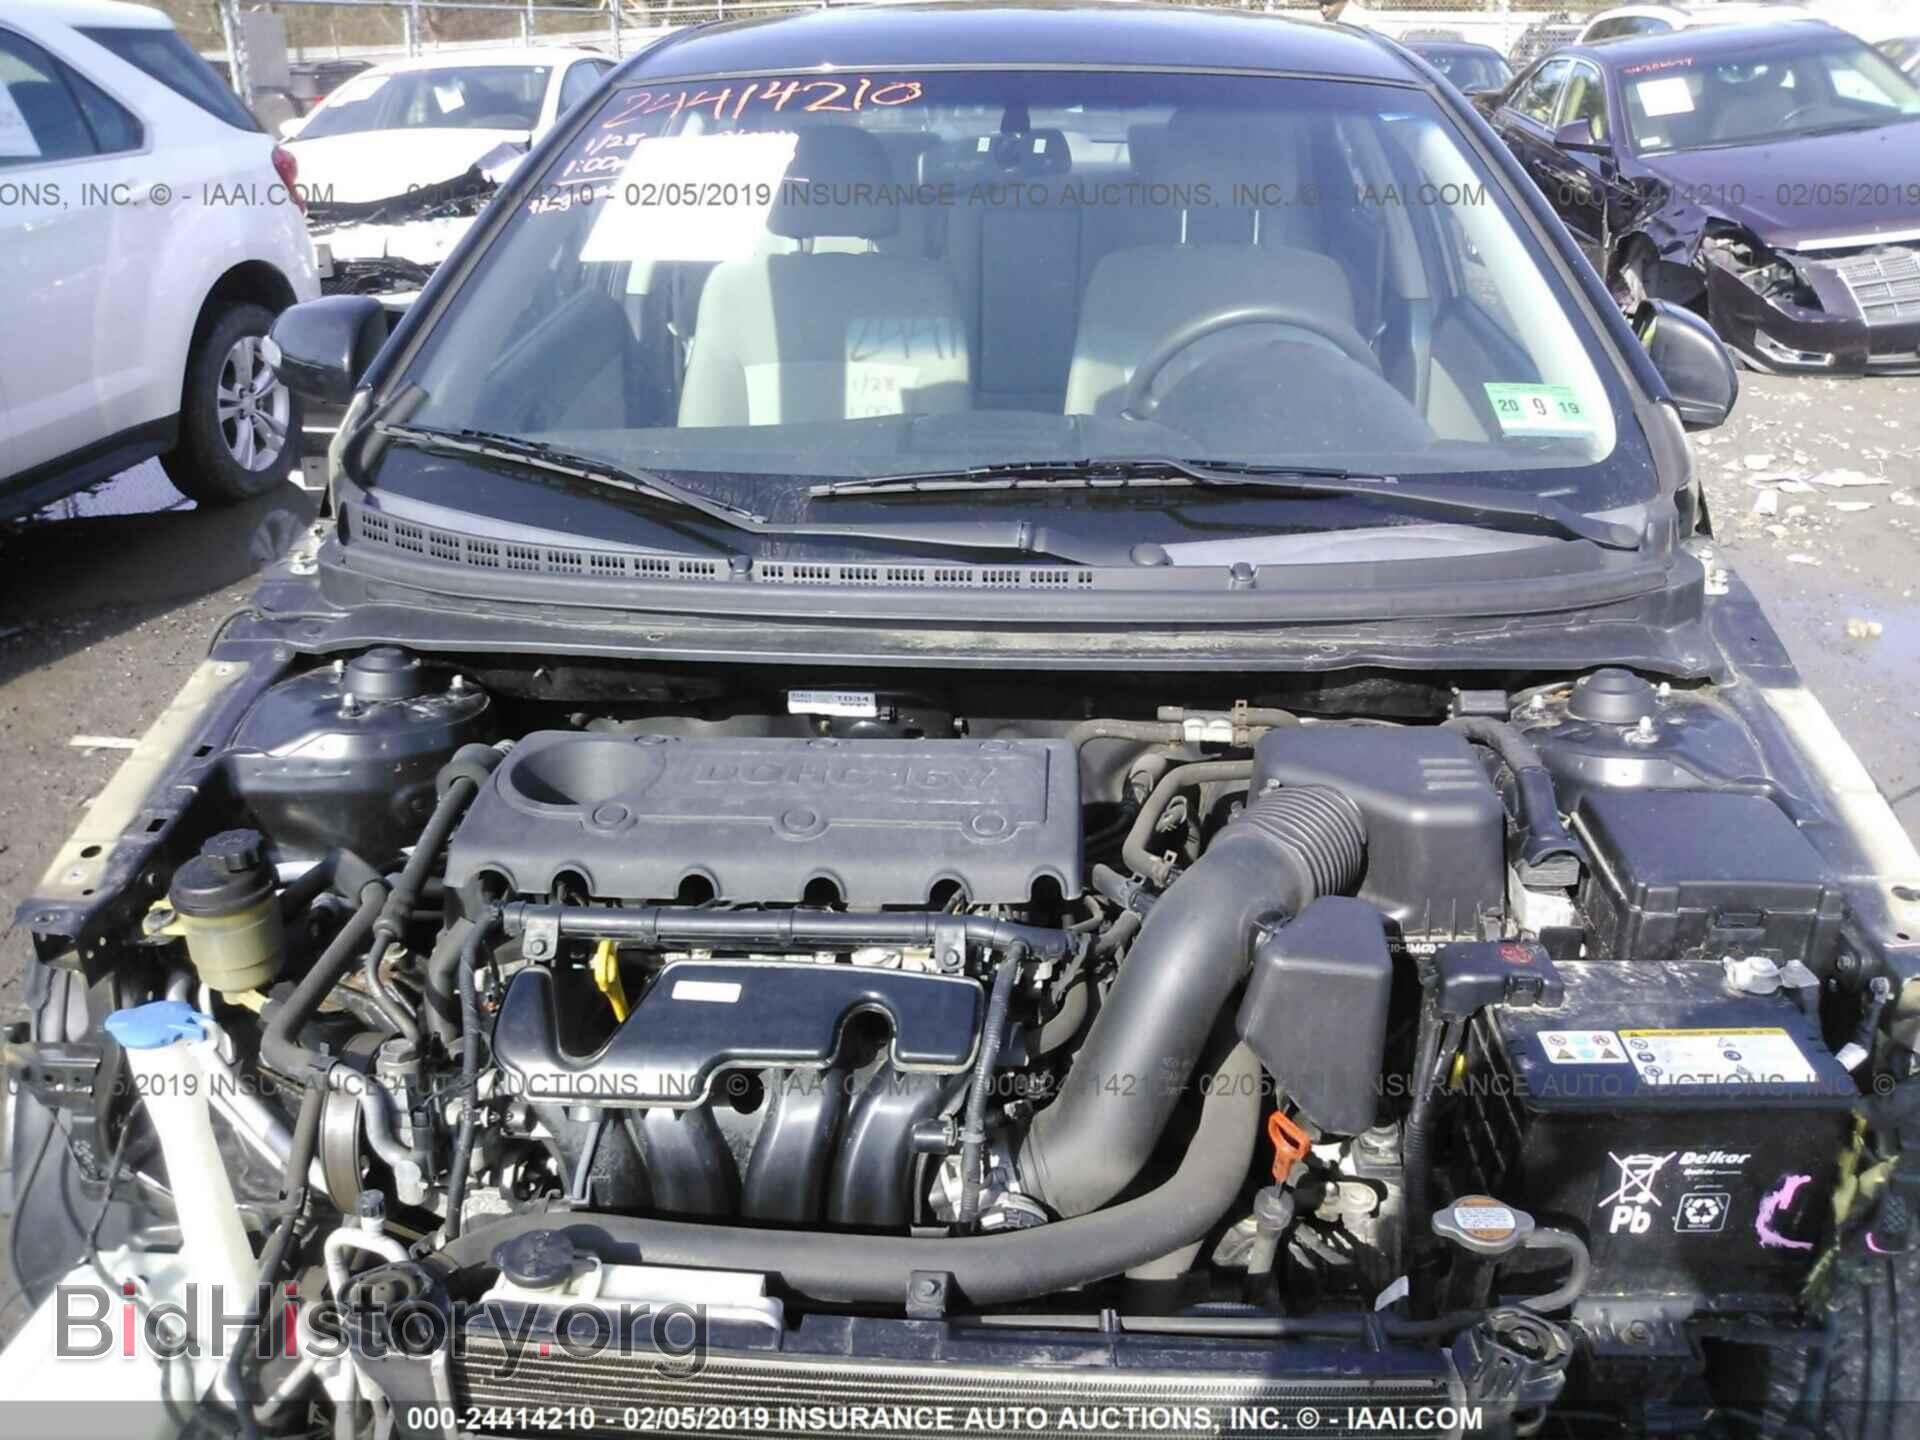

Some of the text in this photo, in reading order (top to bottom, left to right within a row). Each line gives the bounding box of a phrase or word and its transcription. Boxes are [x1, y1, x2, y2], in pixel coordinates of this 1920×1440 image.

[1498, 397, 1580, 416] 20 9 19
[1679, 1150, 1751, 1165] Delkor
[1609, 1205, 1652, 1234] Pb
